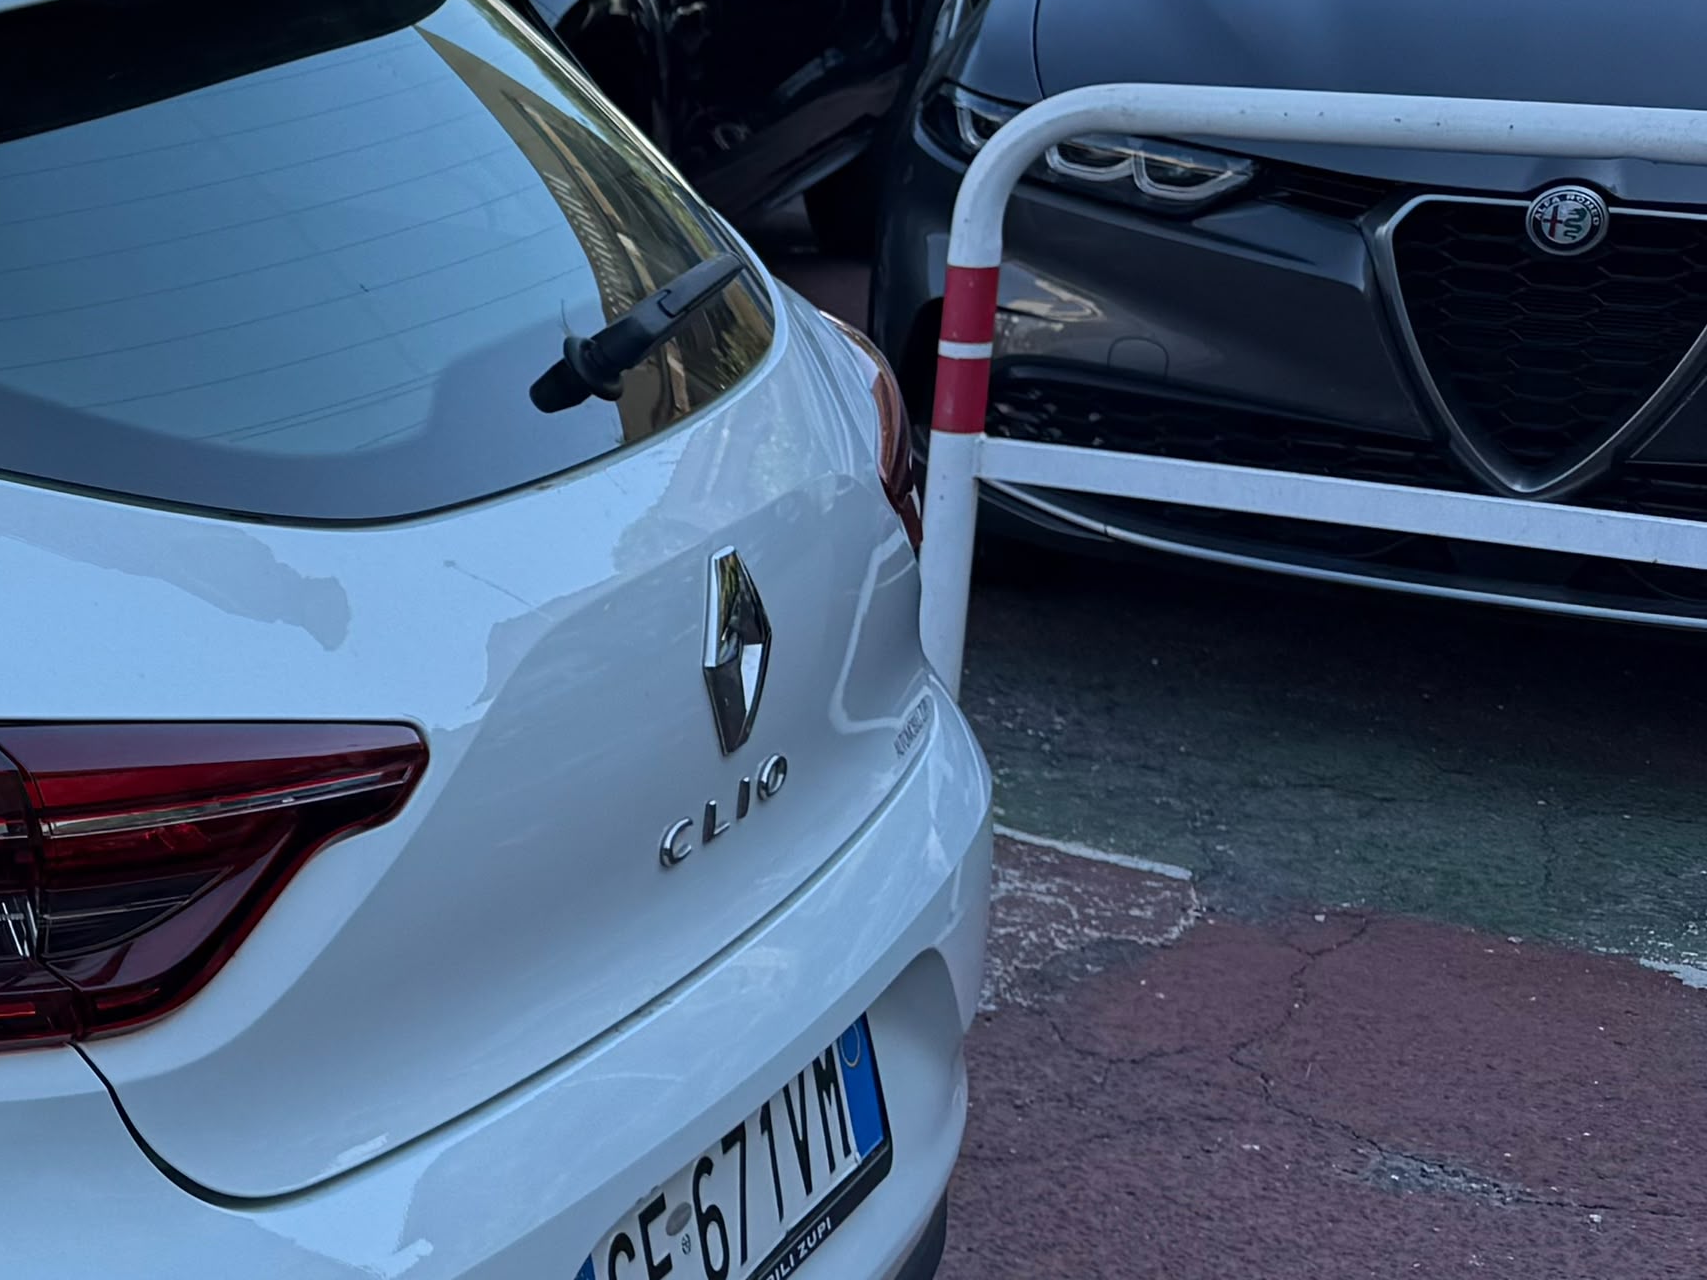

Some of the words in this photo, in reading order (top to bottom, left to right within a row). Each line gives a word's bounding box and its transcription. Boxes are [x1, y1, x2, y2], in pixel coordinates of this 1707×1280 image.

[1534, 195, 1561, 221] ALFA
[659, 753, 788, 869] CLIO
[796, 1216, 832, 1259] ZUPI
